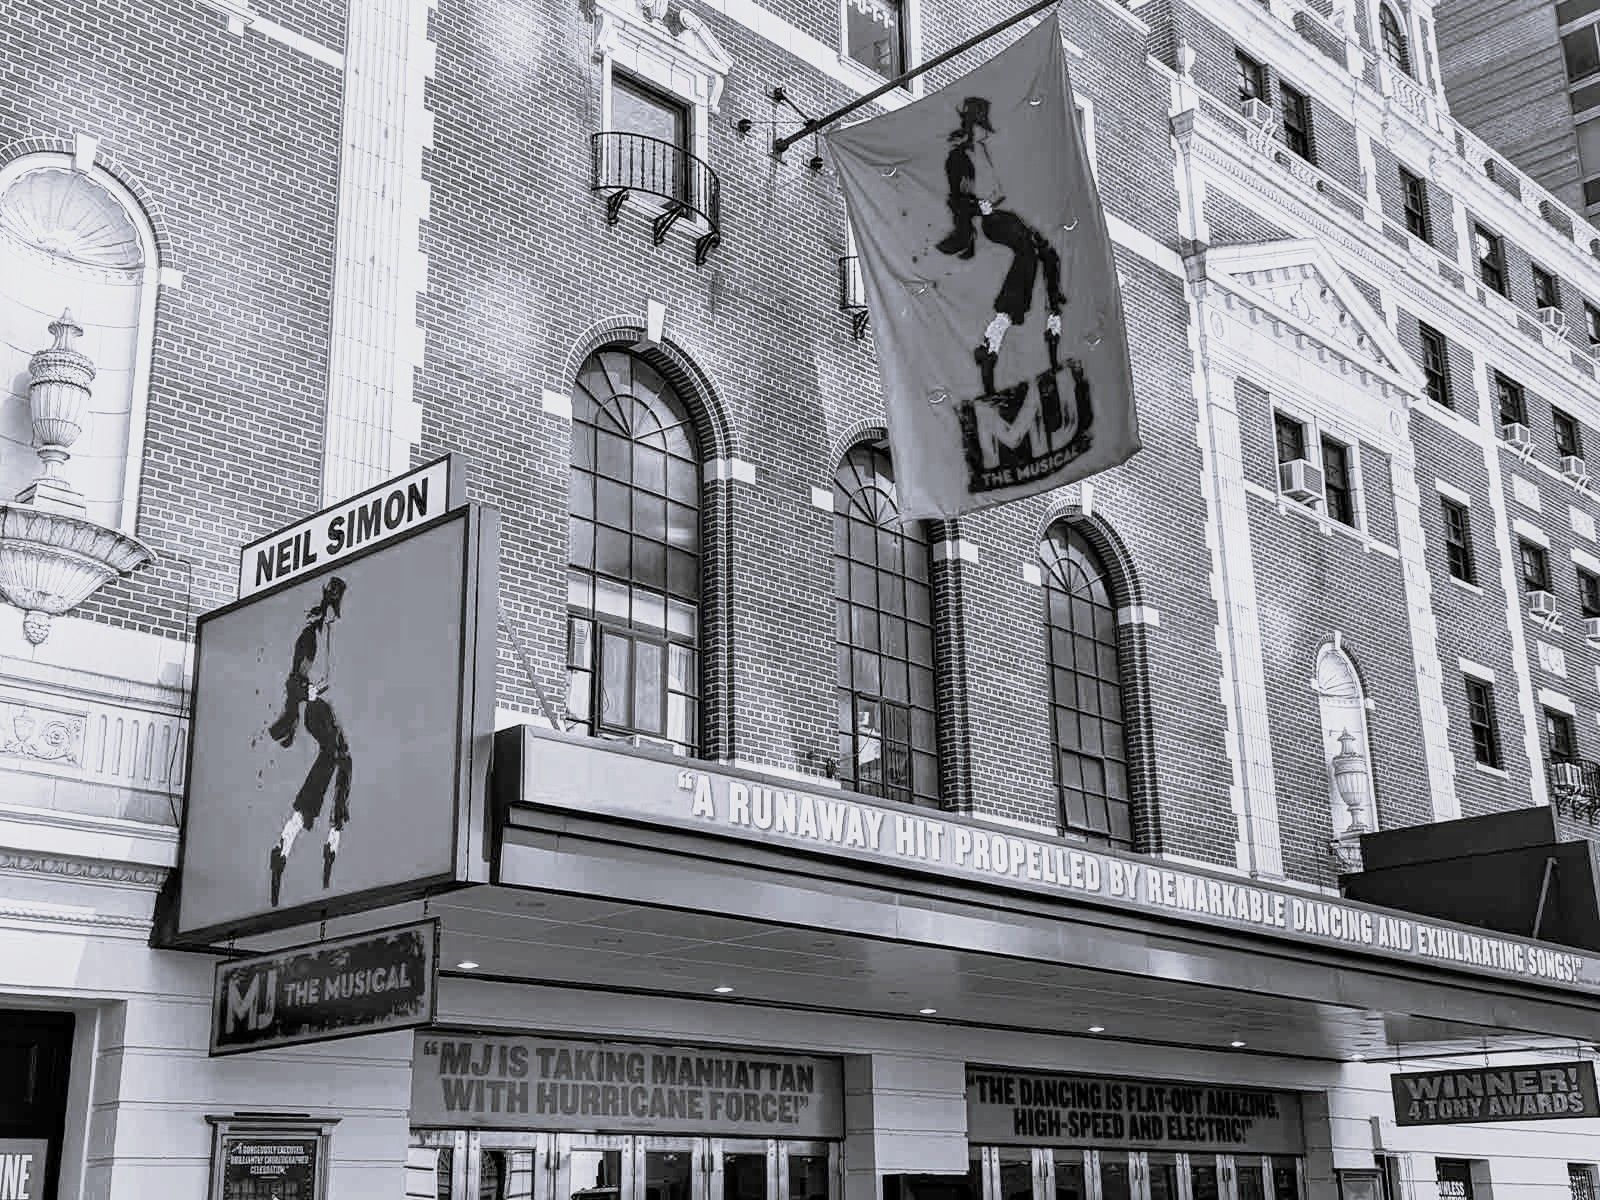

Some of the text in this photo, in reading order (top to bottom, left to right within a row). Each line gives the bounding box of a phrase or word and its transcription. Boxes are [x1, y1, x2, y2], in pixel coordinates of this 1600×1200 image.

[973, 366, 1079, 470] MJ
[981, 445, 1080, 487] THE MUSICAL
[255, 477, 428, 587] NEIL SIMON
[729, 781, 883, 849] RUNAWAY
[895, 815, 943, 860] HIT
[955, 827, 1100, 891] PROPELLED
[1109, 859, 1140, 898] BY
[1149, 869, 1285, 927] REMARKABLE
[1293, 898, 1373, 944] DANCING
[1378, 917, 1411, 950] AND
[1417, 925, 1525, 972] EXHILARATING
[225, 969, 278, 1034] MJ
[284, 963, 411, 1007] THE MUSICAL
[500, 1045, 529, 1078] IS
[536, 1047, 646, 1083] TAKING
[651, 1054, 814, 1093] MANHATTAN
[1402, 1067, 1577, 1099] WINNER!
[441, 1078, 529, 1113] WITH
[536, 1082, 703, 1120] HURRICANE
[1020, 1078, 1101, 1110] DANCING
[1106, 1082, 1122, 1109] IS
[1127, 1084, 1203, 1115] FLAT-OUT
[1408, 1092, 1584, 1121] 4 TONY AWARDS
[1013, 1107, 1124, 1139] HIGH-SPEED
[1129, 1115, 1163, 1141] AND
